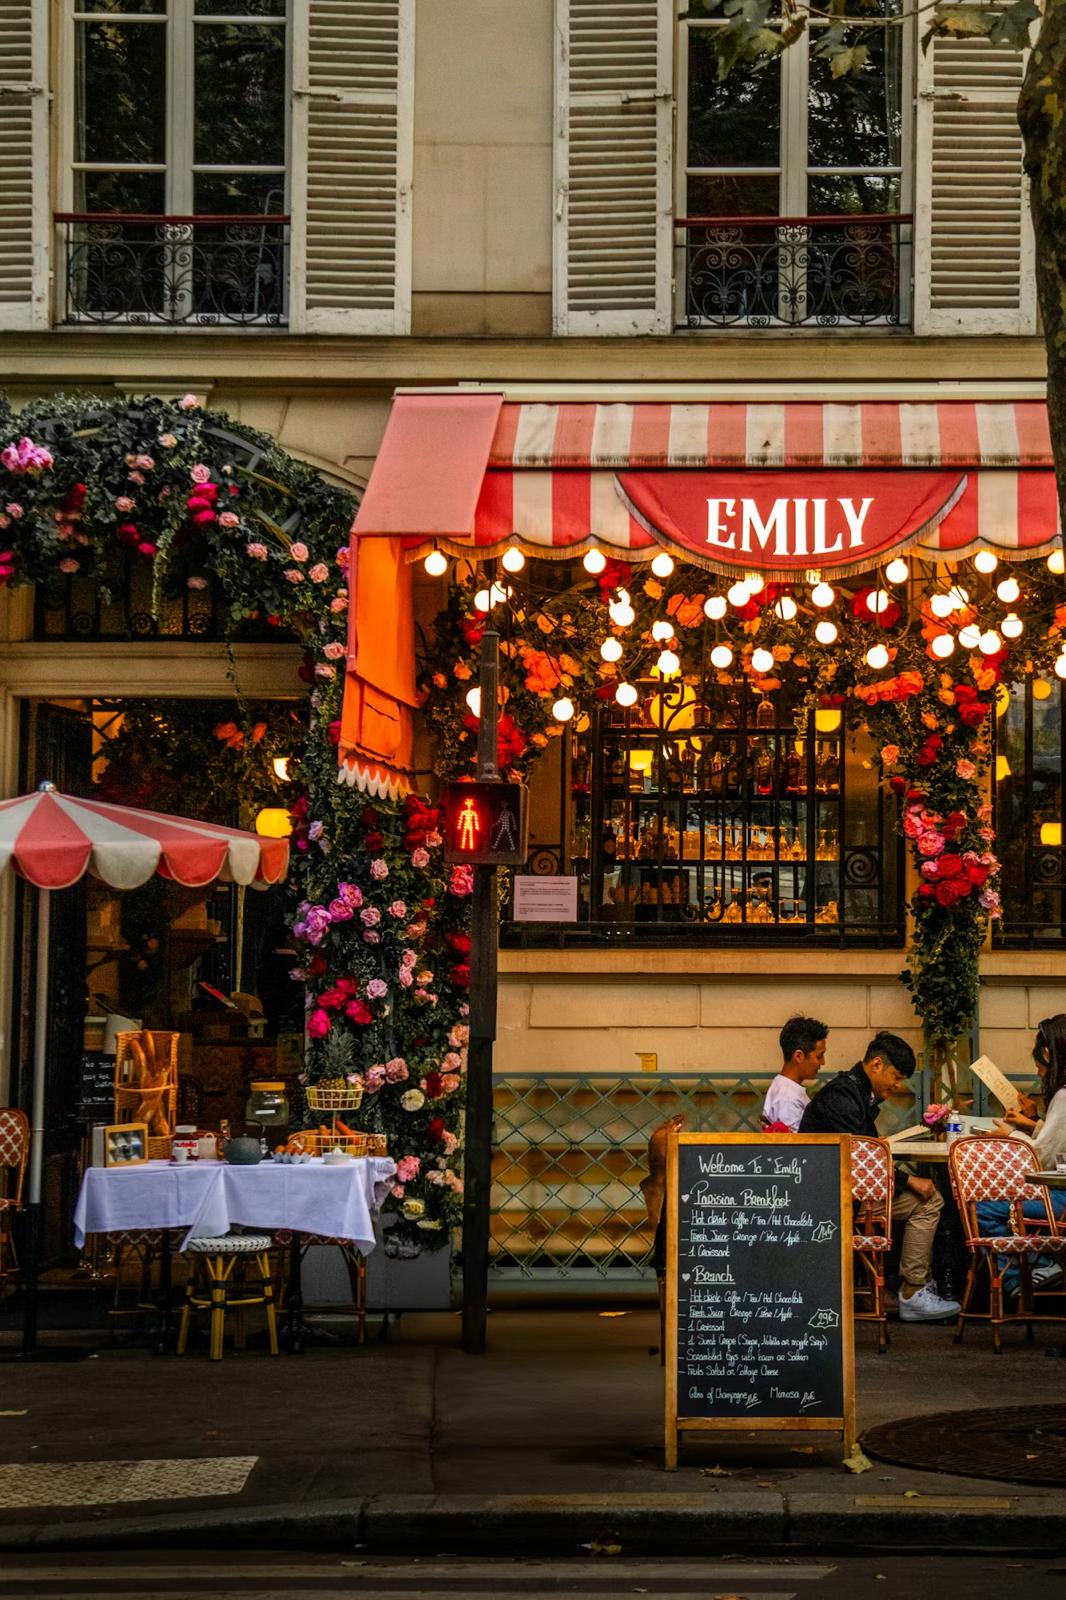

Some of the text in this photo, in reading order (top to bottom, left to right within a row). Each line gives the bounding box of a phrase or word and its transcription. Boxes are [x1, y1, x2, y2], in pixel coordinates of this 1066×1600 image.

[705, 498, 875, 556] EMILY
[698, 1152, 745, 1174] Welcome
[747, 1155, 762, 1174] To
[740, 1185, 792, 1214] Breakfast
[691, 1209, 704, 1226] Hot
[689, 1288, 702, 1303] Hot
[770, 1387, 800, 1399] Mimosa
